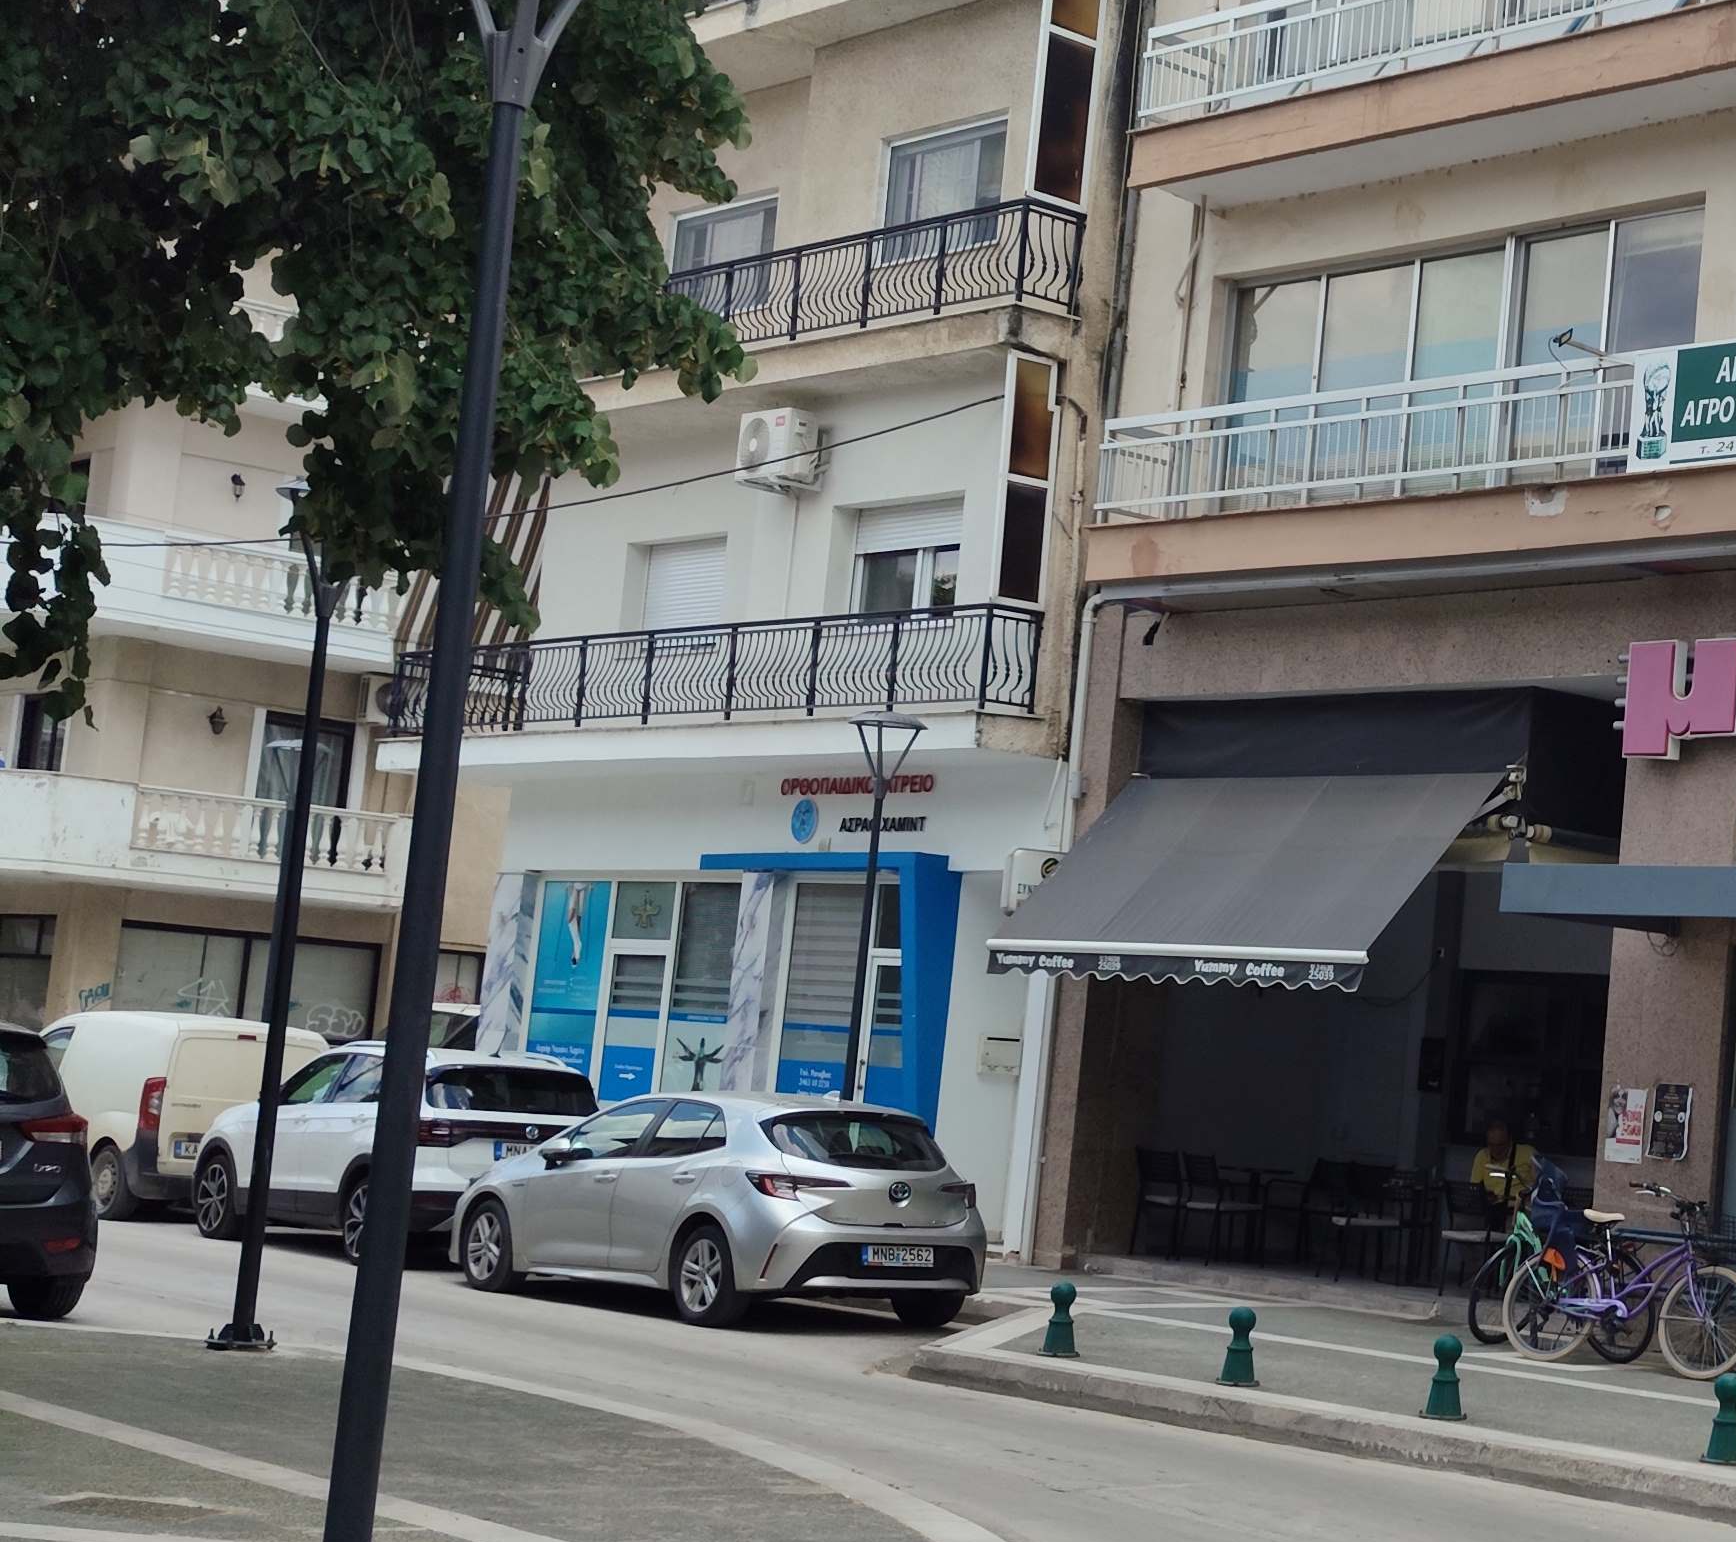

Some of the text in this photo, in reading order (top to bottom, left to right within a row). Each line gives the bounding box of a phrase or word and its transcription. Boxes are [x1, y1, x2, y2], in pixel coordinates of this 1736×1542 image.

[886, 774, 935, 793] ΑΤΡΕΙΟ
[996, 953, 1074, 968] Yummy Coffee
[1194, 959, 1285, 977] Yummy Coffee
[1308, 970, 1335, 981] 25039
